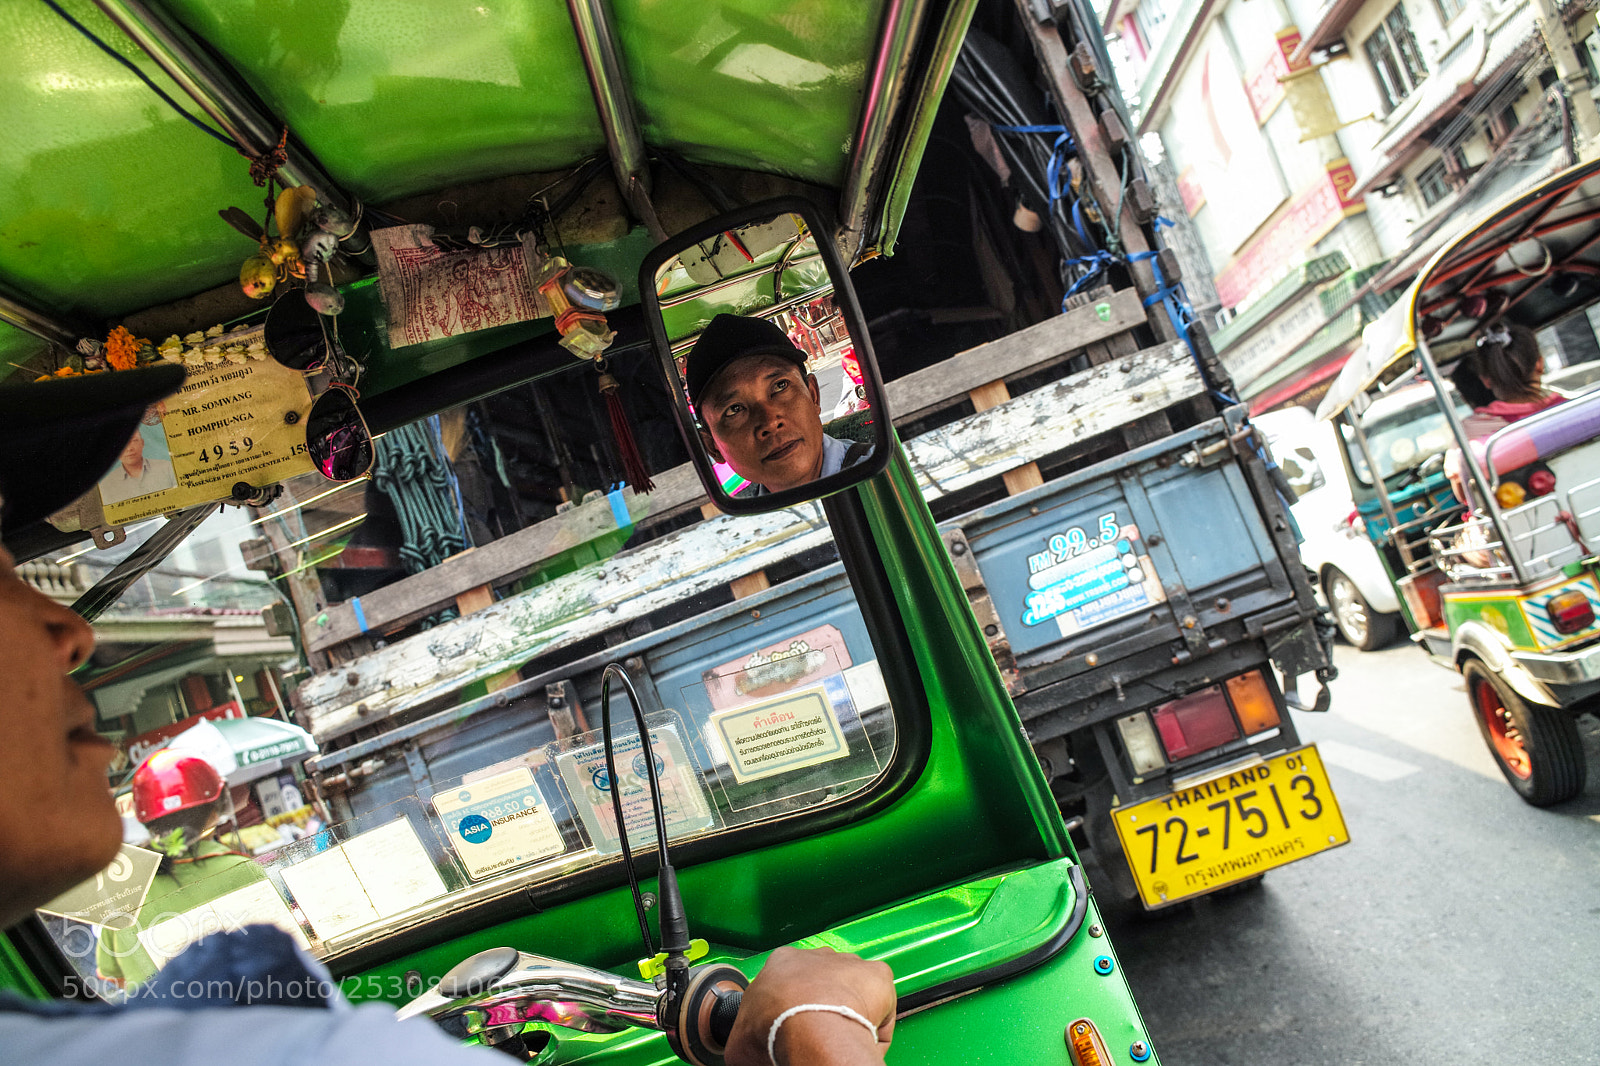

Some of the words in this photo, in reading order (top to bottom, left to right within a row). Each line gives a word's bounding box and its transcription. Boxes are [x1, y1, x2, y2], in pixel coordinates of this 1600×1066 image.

[182, 403, 200, 418] MR.
[201, 390, 253, 413] SOMWANG
[187, 412, 254, 437] HOMPHU-NGA
[187, 474, 221, 489] PASSENGER
[259, 461, 281, 471] CENTER
[1029, 551, 1050, 574] FM
[1049, 512, 1120, 562] 99.5
[753, 709, 795, 730] คำเตือน
[1161, 764, 1271, 811] THAILAND
[1286, 755, 1305, 770] 01
[463, 822, 490, 838] ASIA
[491, 806, 539, 828] INSURANCE
[1136, 774, 1322, 874] 72-7513
[1184, 837, 1305, 887] กรุงเทพมหานคร
